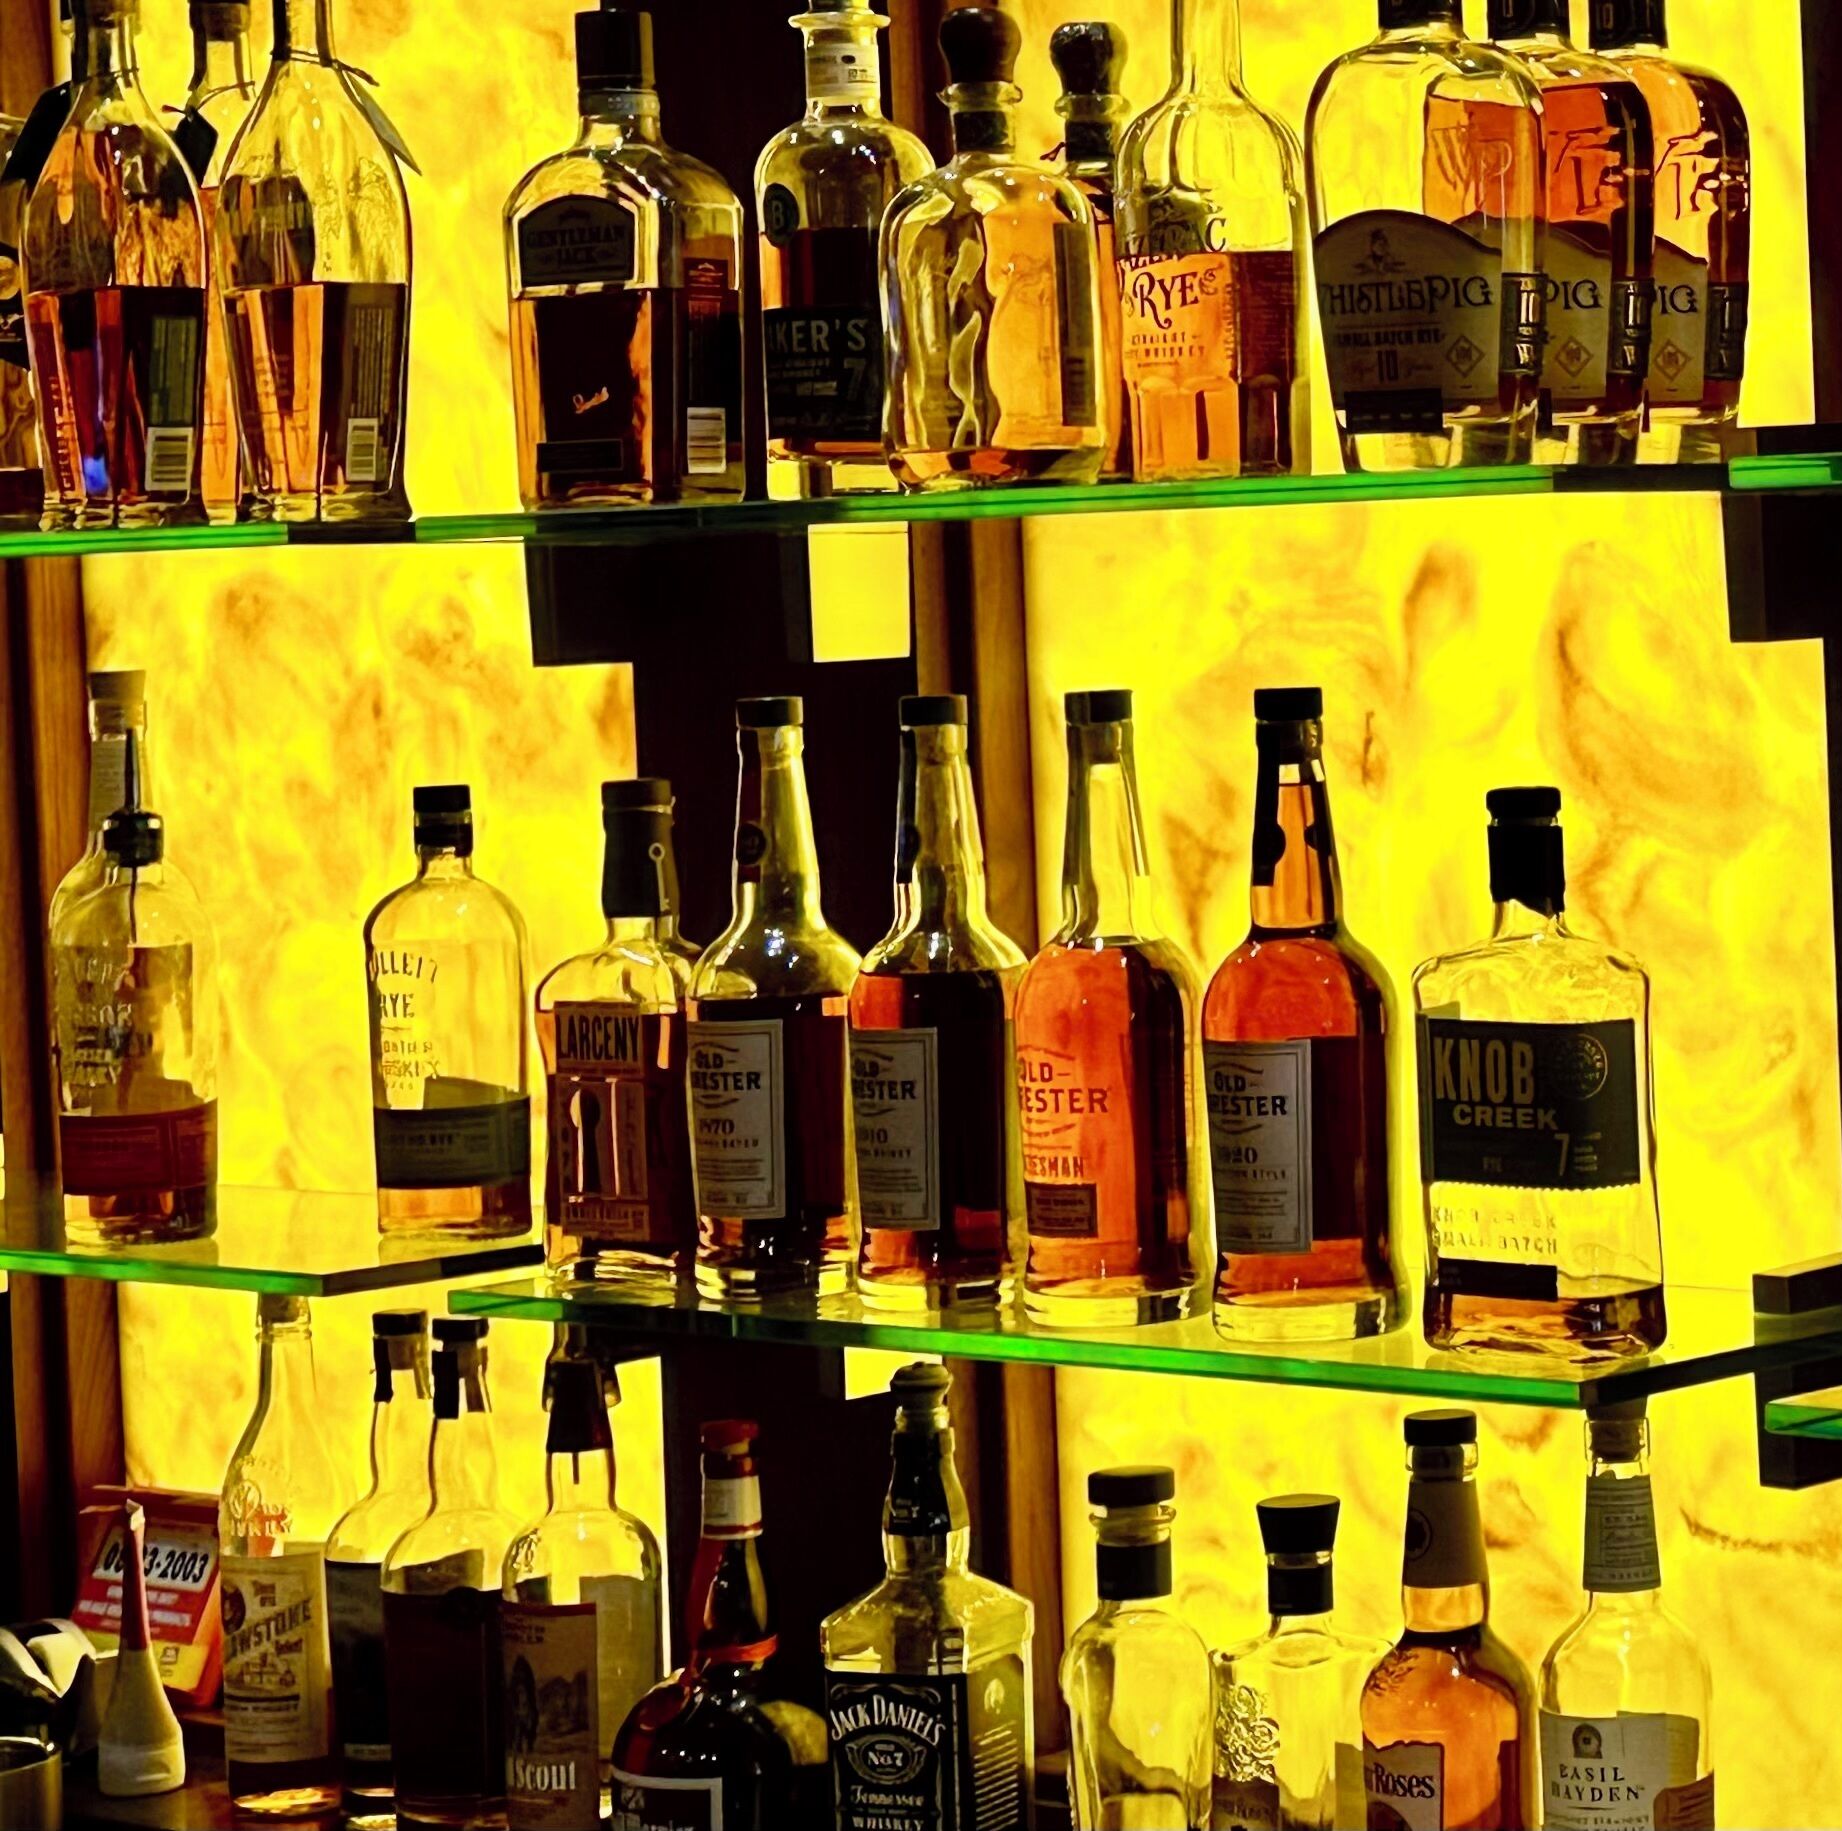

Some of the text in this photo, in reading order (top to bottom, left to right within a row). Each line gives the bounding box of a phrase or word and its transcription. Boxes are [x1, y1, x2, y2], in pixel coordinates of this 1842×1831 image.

[1132, 271, 1200, 331] RYE
[556, 1013, 641, 1062] LARCENY
[1213, 1070, 1246, 1093] OLD
[1433, 1036, 1535, 1104] KNOB
[1452, 1103, 1560, 1131] CREEK
[1554, 1132, 1571, 1178] 7
[829, 1693, 948, 1747] JACK DANIEL'S
[515, 1759, 577, 1791] Scout
[1374, 1761, 1436, 1799] Roses
[1551, 1780, 1641, 1803] HAYDEN
[1558, 1762, 1627, 1783] BASIL
